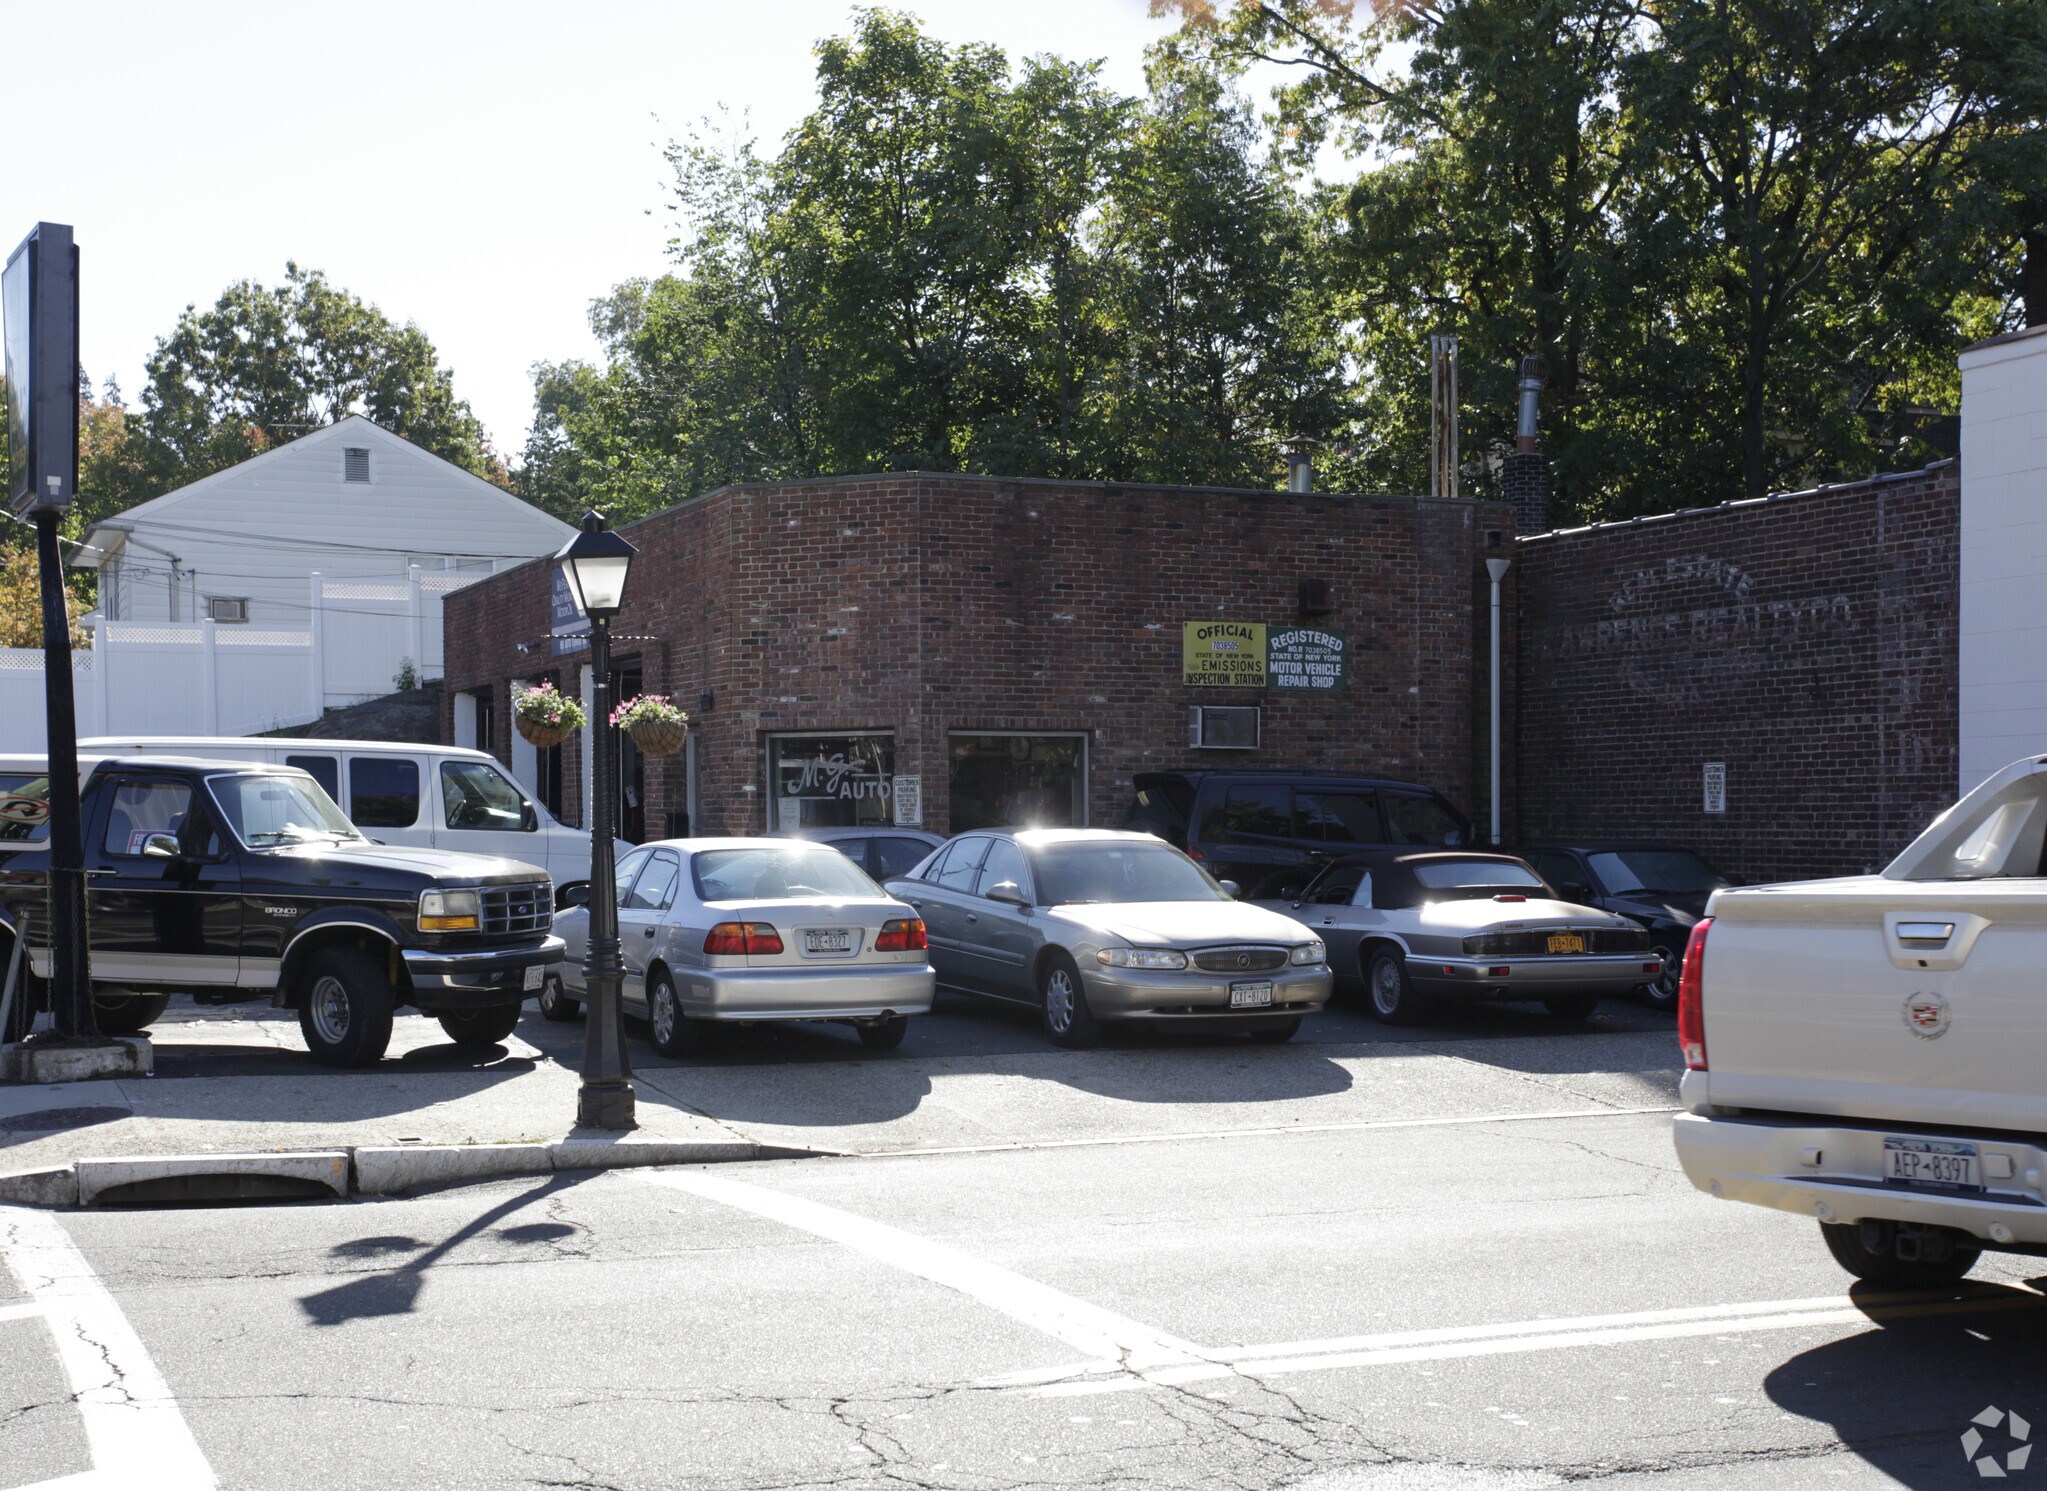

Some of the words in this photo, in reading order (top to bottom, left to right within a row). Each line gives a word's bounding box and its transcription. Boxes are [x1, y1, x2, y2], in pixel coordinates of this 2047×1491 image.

[1197, 624, 1254, 640] OFFICIAL
[1212, 641, 1239, 651] 7038505
[1270, 630, 1343, 652] REGISTERED
[1270, 652, 1291, 660] STATE
[1293, 653, 1303, 661] OF
[1202, 660, 1262, 672] EMISSIONS
[1270, 662, 1302, 674] MOTOR
[1305, 663, 1342, 676] VEHICLE
[1186, 673, 1230, 685] INSPECTION
[1234, 673, 1265, 686] STATION
[1278, 675, 1309, 687] REPAIR
[1311, 676, 1334, 688] SHOP
[895, 779, 919, 787] CUSTOMER
[840, 781, 891, 800] AUTO
[265, 906, 297, 914] BRONCO
